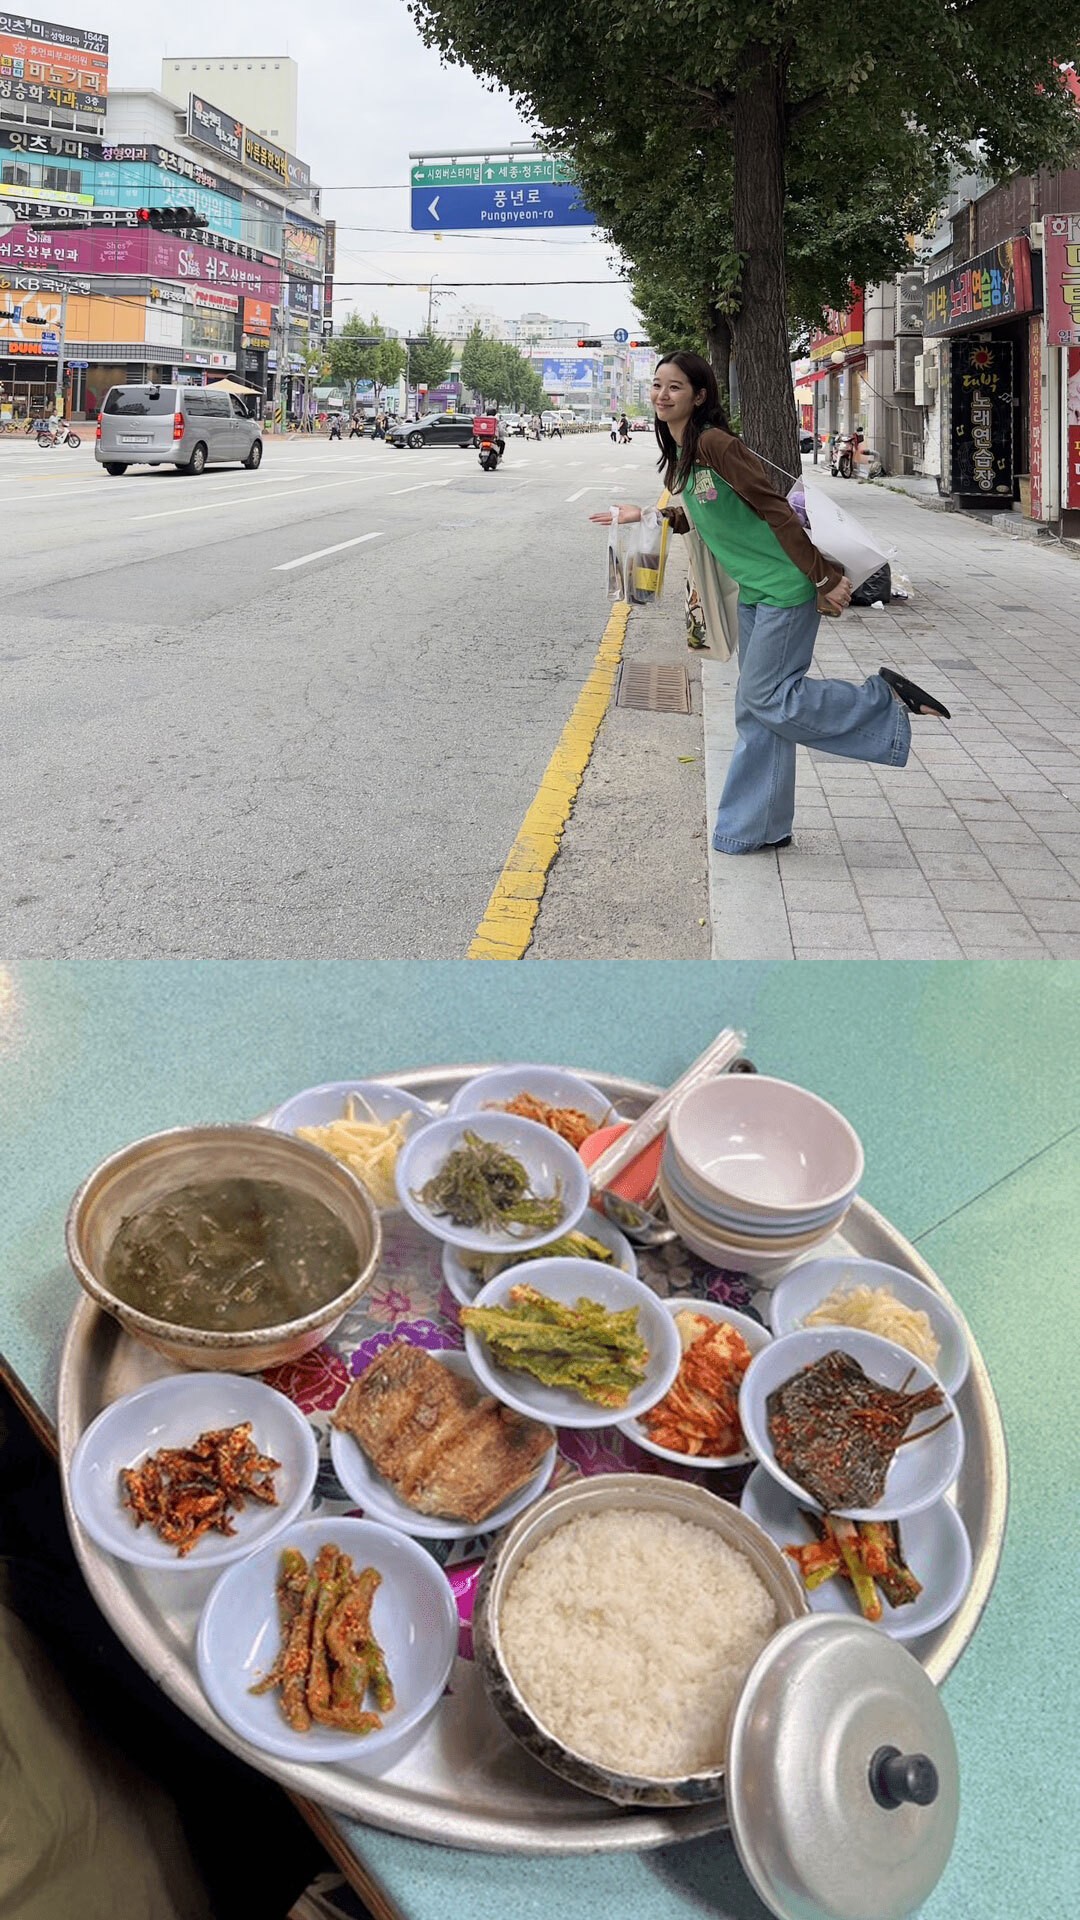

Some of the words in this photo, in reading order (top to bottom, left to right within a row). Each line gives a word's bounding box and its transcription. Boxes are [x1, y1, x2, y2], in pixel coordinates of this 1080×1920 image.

[83, 40, 105, 52] 7747
[29, 63, 101, 92] 비뇨기과
[47, 88, 77, 109] 치과
[102, 147, 148, 161] 성형외과
[246, 137, 287, 177] 바른몸한의원
[428, 167, 480, 180] 시외버스터미널
[493, 189, 541, 208] 풍년로
[481, 210, 554, 223] Pungnyeon-ro
[1051, 217, 1080, 241] 화
[0, 242, 78, 262] 쉬즈산부인과
[926, 285, 948, 324] 대박
[950, 268, 1003, 318] 노래연습장
[962, 373, 1000, 393] 대박
[971, 391, 995, 490] 노래연습장
